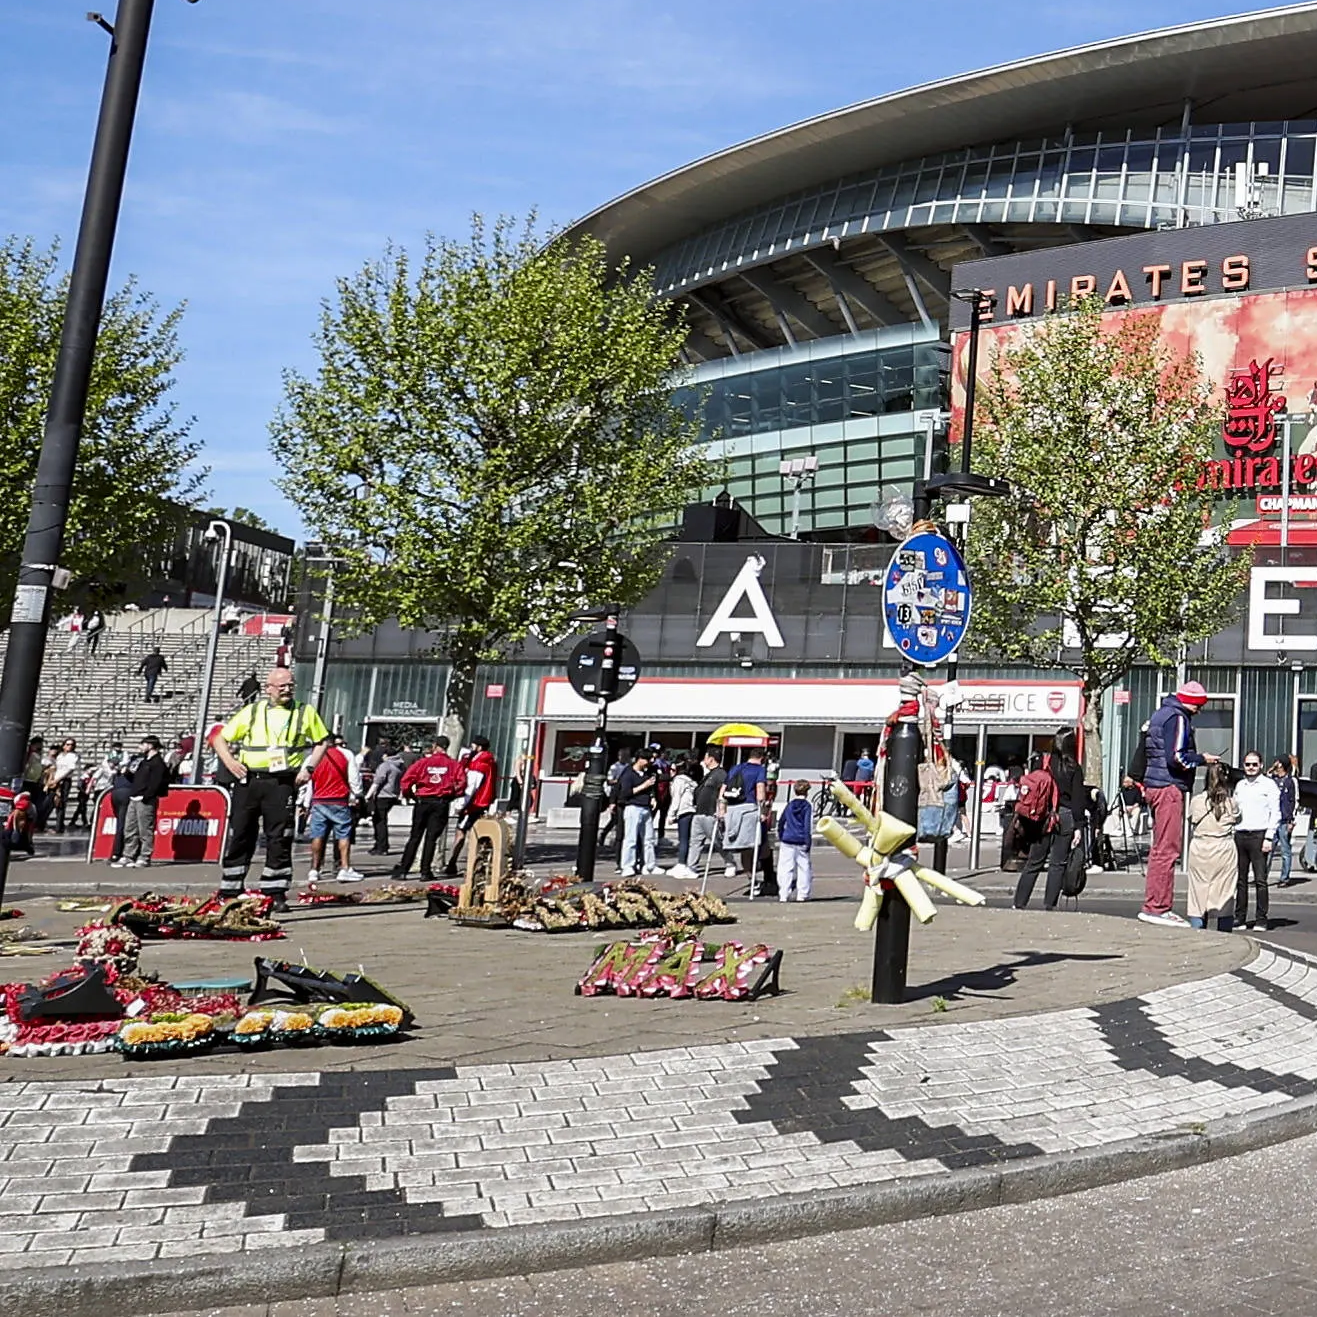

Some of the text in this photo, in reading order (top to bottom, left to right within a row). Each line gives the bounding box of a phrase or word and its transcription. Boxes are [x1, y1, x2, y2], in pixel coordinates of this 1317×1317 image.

[977, 254, 1252, 322] EMIRATES
[382, 708, 428, 717] ENTRANCE
[393, 701, 418, 710] MEDIA
[173, 818, 219, 837] WOMEN
